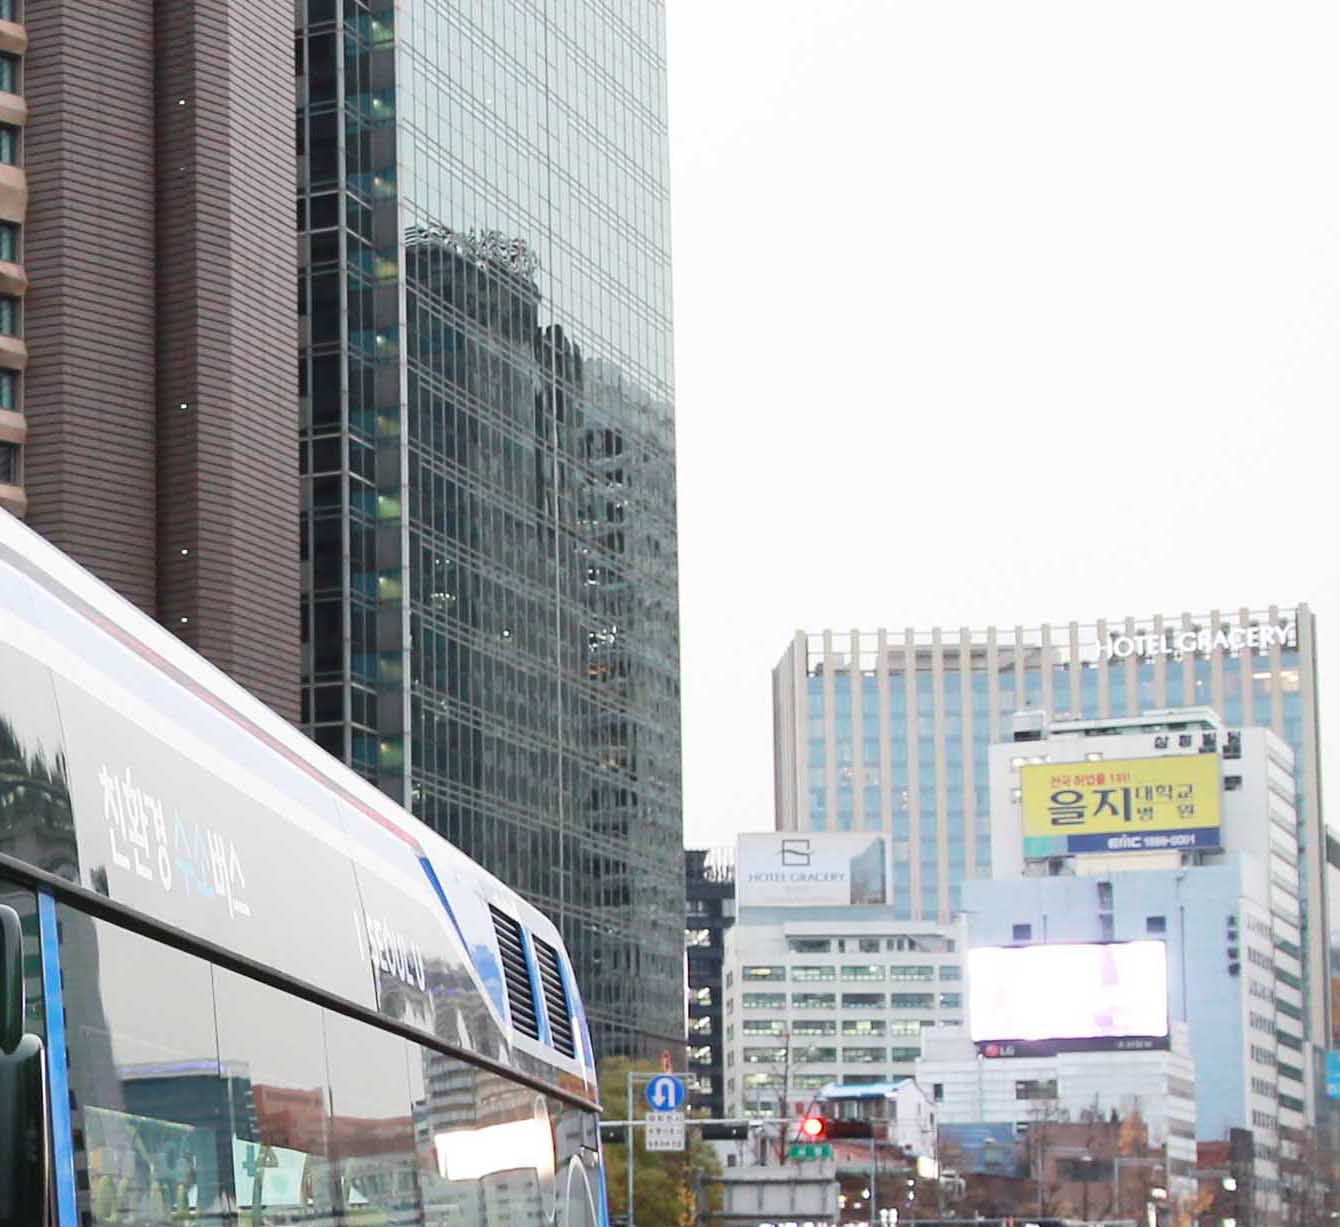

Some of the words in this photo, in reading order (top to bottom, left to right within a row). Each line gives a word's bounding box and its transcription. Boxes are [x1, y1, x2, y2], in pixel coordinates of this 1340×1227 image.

[1096, 632, 1172, 659] HOTEL
[1176, 623, 1291, 652] GRACERY
[1048, 787, 1131, 826] 을지
[1135, 784, 1193, 801] 대학교
[99, 764, 172, 892] 친환경
[174, 812, 251, 920] 수소버스
[748, 872, 786, 882] HOTEL
